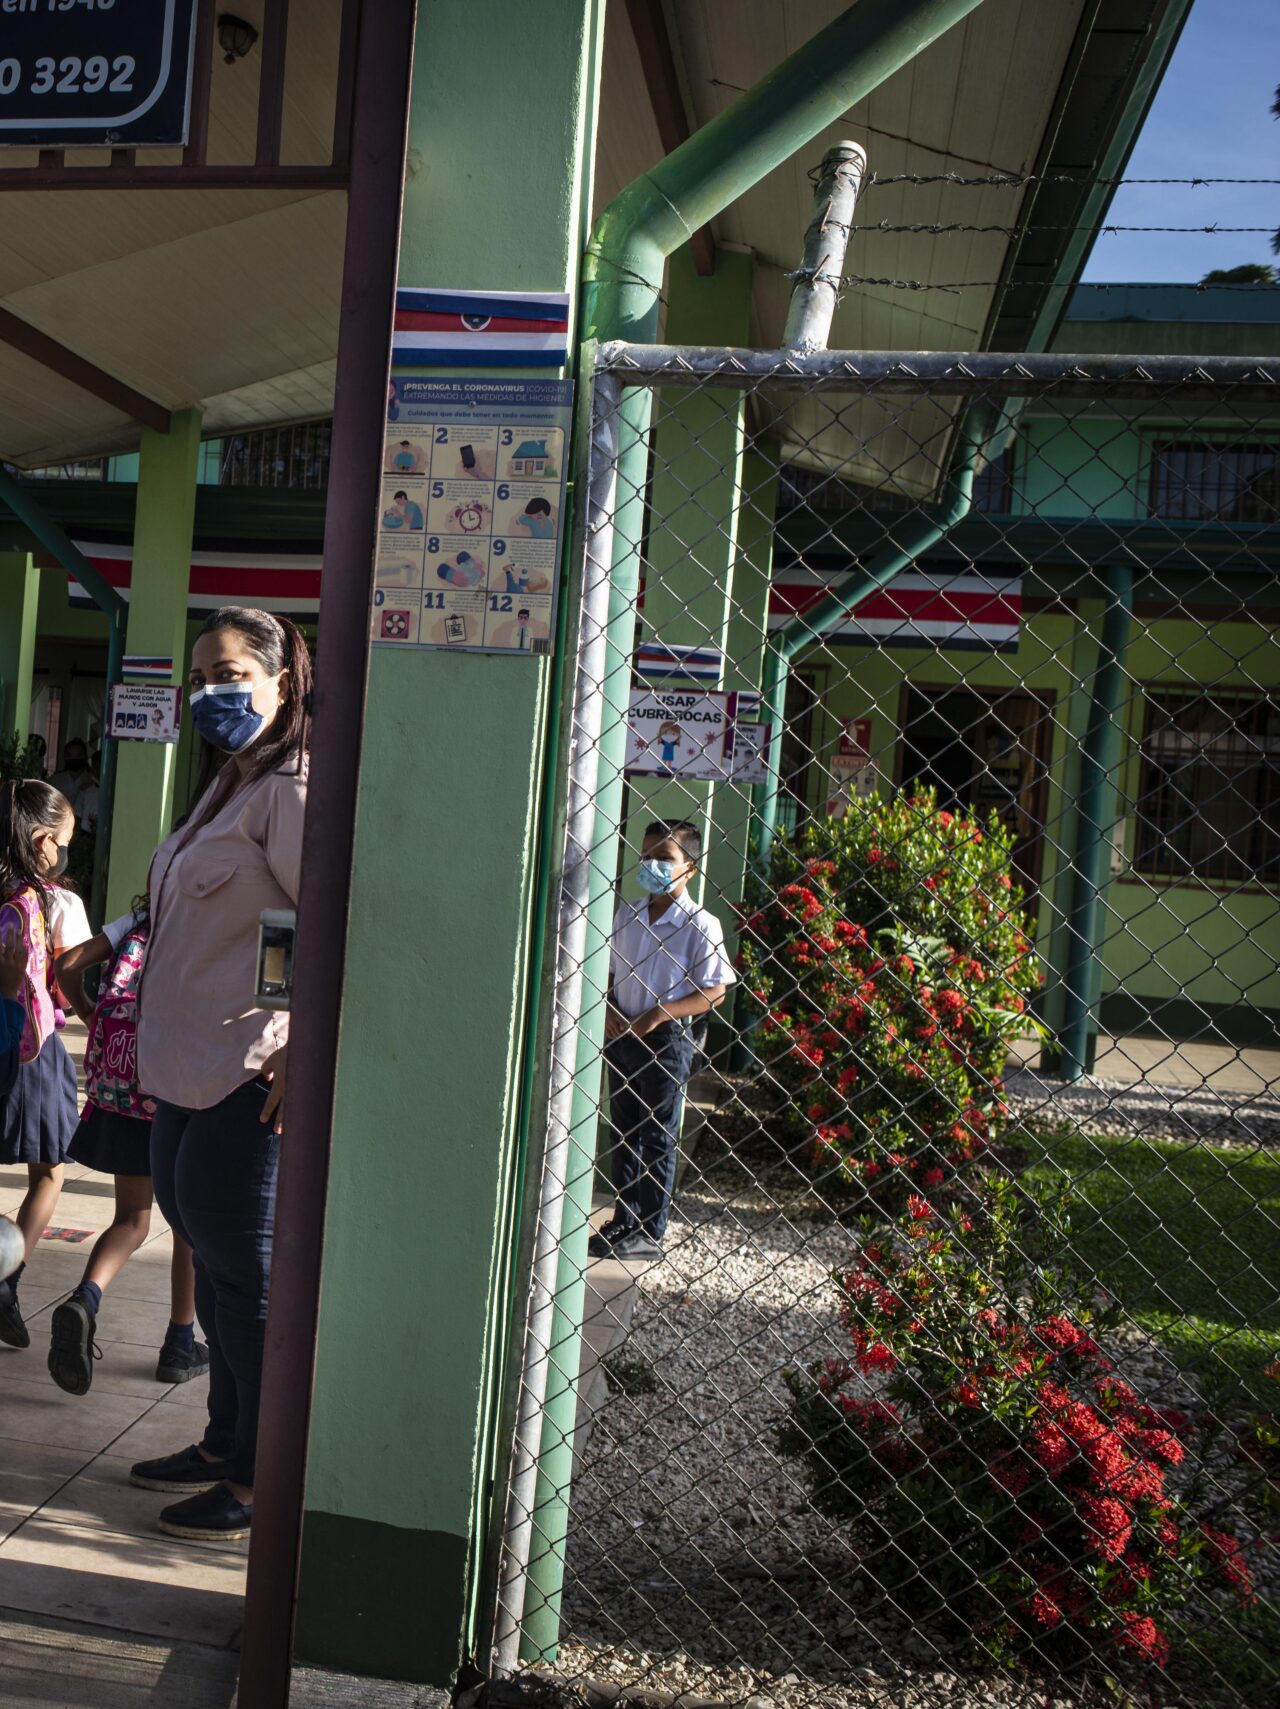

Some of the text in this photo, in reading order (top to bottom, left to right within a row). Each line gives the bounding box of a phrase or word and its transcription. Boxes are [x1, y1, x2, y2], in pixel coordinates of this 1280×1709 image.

[30, 55, 136, 94] 3292
[403, 392, 458, 400] EXTREMANDO
[476, 393, 514, 401] MEDIDAS
[464, 384, 525, 393] CORONAVIRUS
[435, 427, 448, 444] 2
[501, 429, 513, 446] 3
[432, 482, 444, 498] 5
[496, 484, 510, 500] 6
[427, 537, 440, 553] 8
[493, 539, 506, 555] 9
[424, 592, 446, 609] 11
[489, 595, 513, 612] 12
[655, 695, 696, 707] USAR
